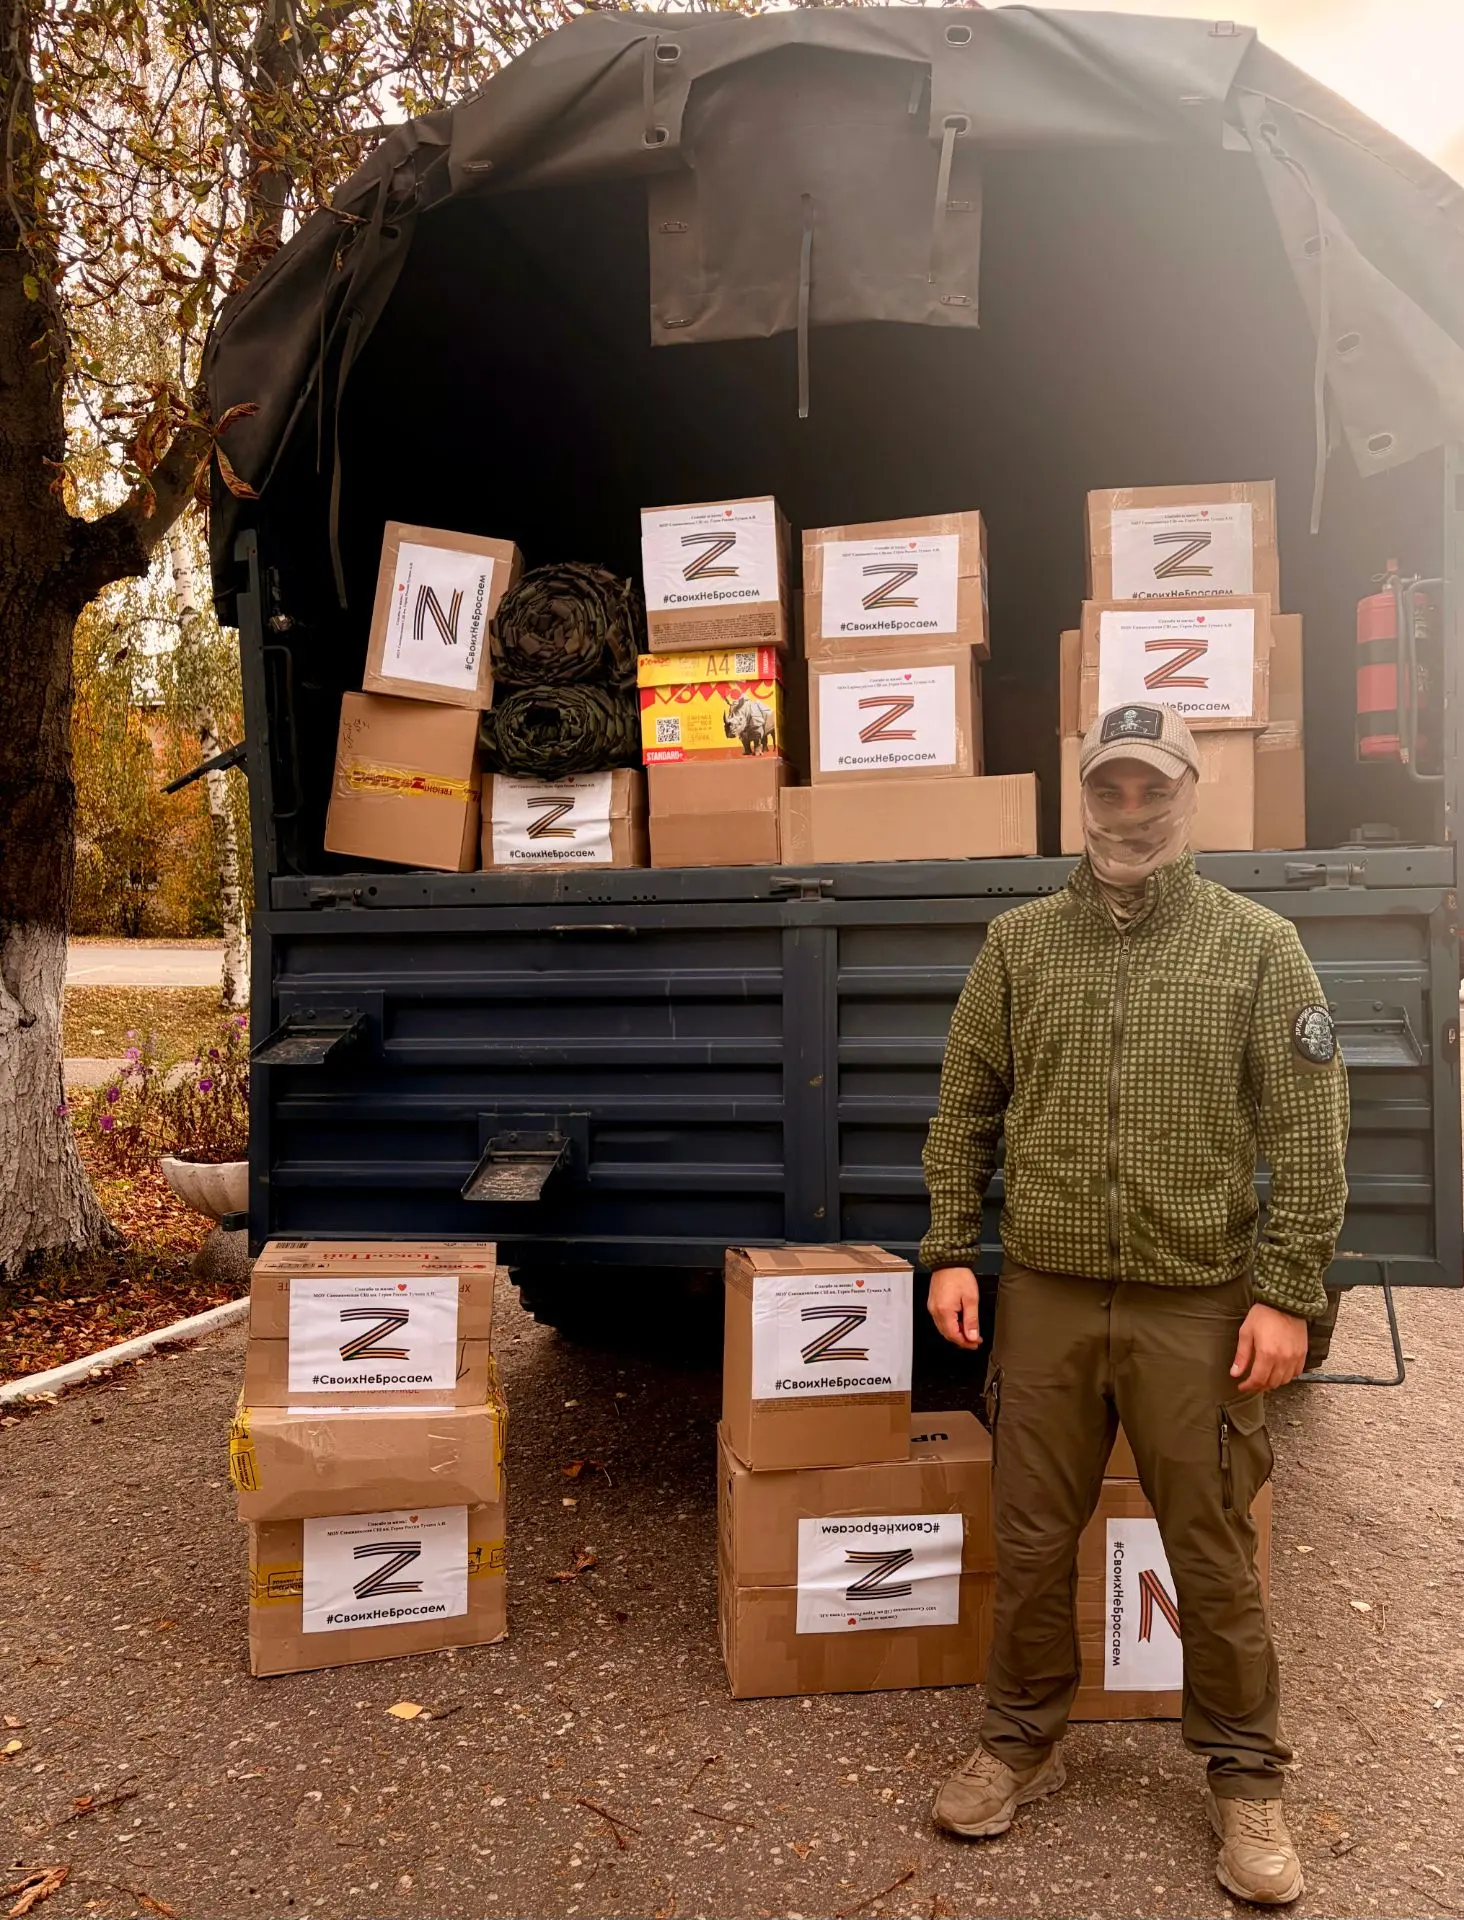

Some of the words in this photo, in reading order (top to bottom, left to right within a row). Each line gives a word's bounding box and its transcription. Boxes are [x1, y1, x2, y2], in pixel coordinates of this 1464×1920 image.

[663, 588, 760, 604] #СвоихНеБросаем
[465, 574, 487, 671] #СвоихНеБросаем
[840, 619, 938, 632] #СвоихНеБросаем
[706, 653, 730, 676] A4
[838, 752, 936, 766] #СвоихНеБросаем
[510, 849, 596, 860] #СвоихНеБросаем
[312, 1373, 433, 1387] #СвоихНеБросаем
[774, 1375, 892, 1391] #СвоихНеБросаем
[821, 1521, 941, 1535] #СвоихНеБросаем
[1110, 1541, 1125, 1667] #СвоихНеБросаем
[326, 1603, 446, 1625] #СвоихНеБросаем
